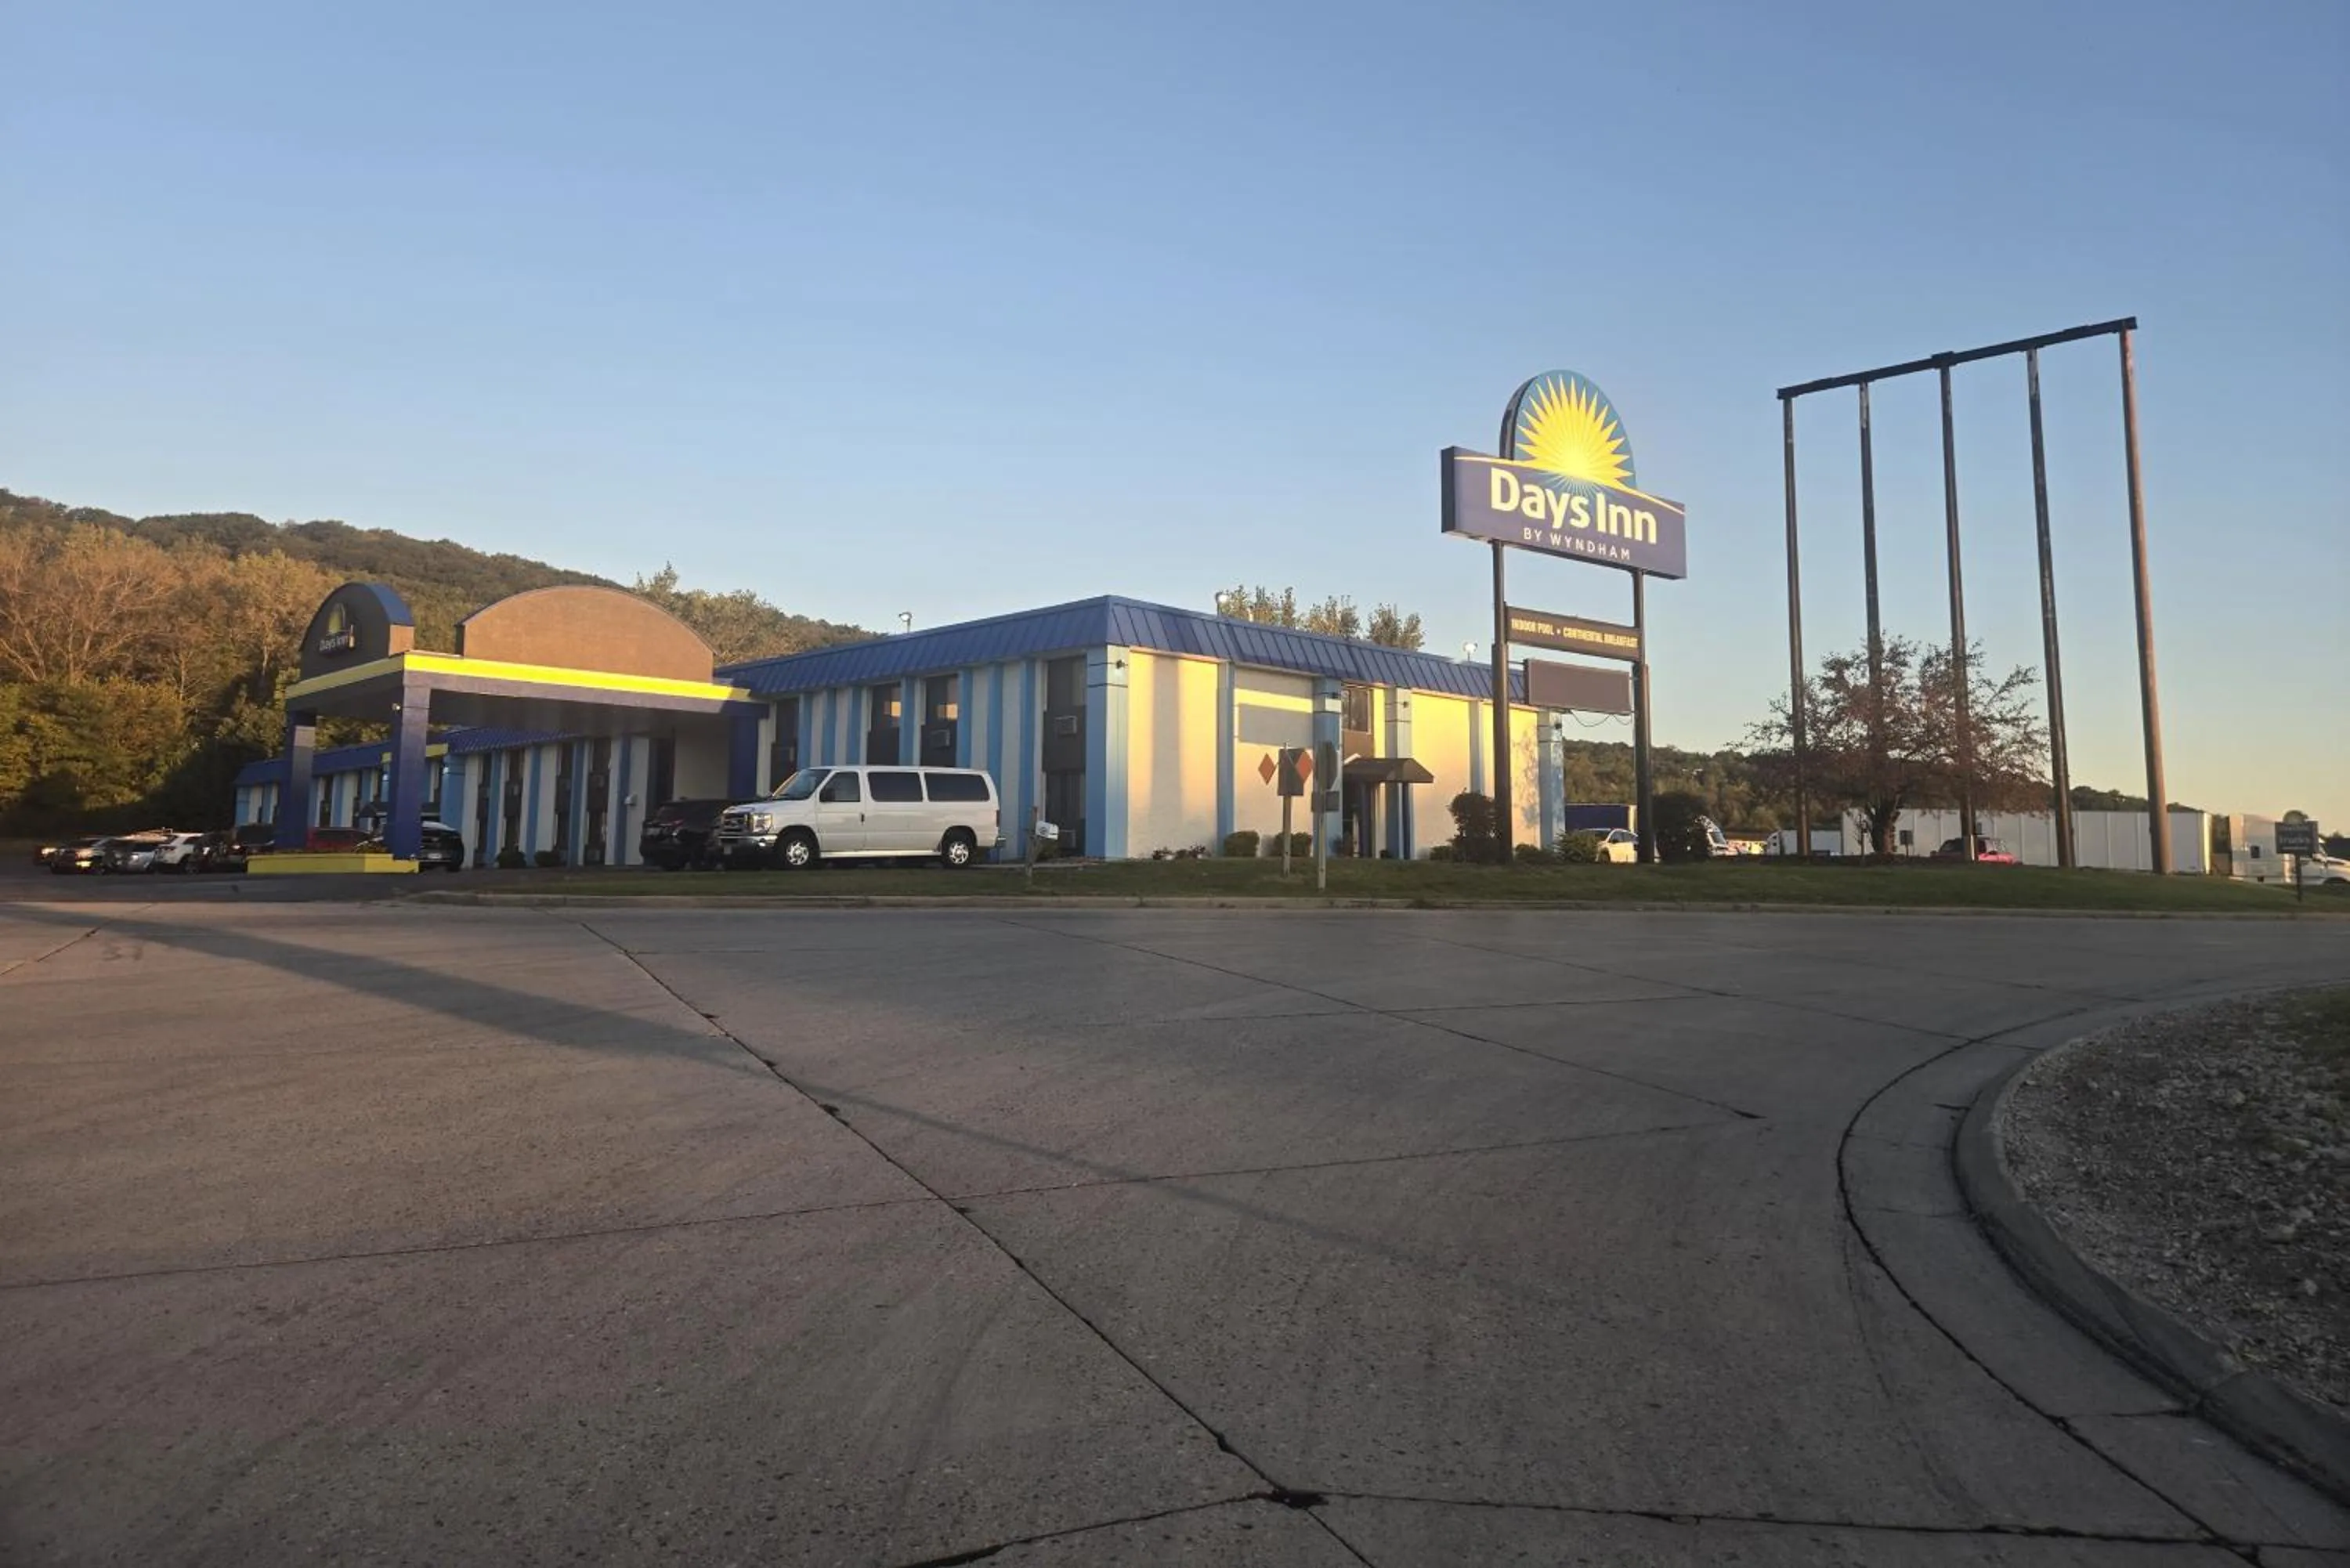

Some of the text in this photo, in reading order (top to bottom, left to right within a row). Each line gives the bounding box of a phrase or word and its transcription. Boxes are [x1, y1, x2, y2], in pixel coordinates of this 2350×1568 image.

[1491, 467, 1657, 544] Days Inn
[1523, 527, 1631, 560] BY WYNDHAM
[1538, 623, 1555, 635] POOL
